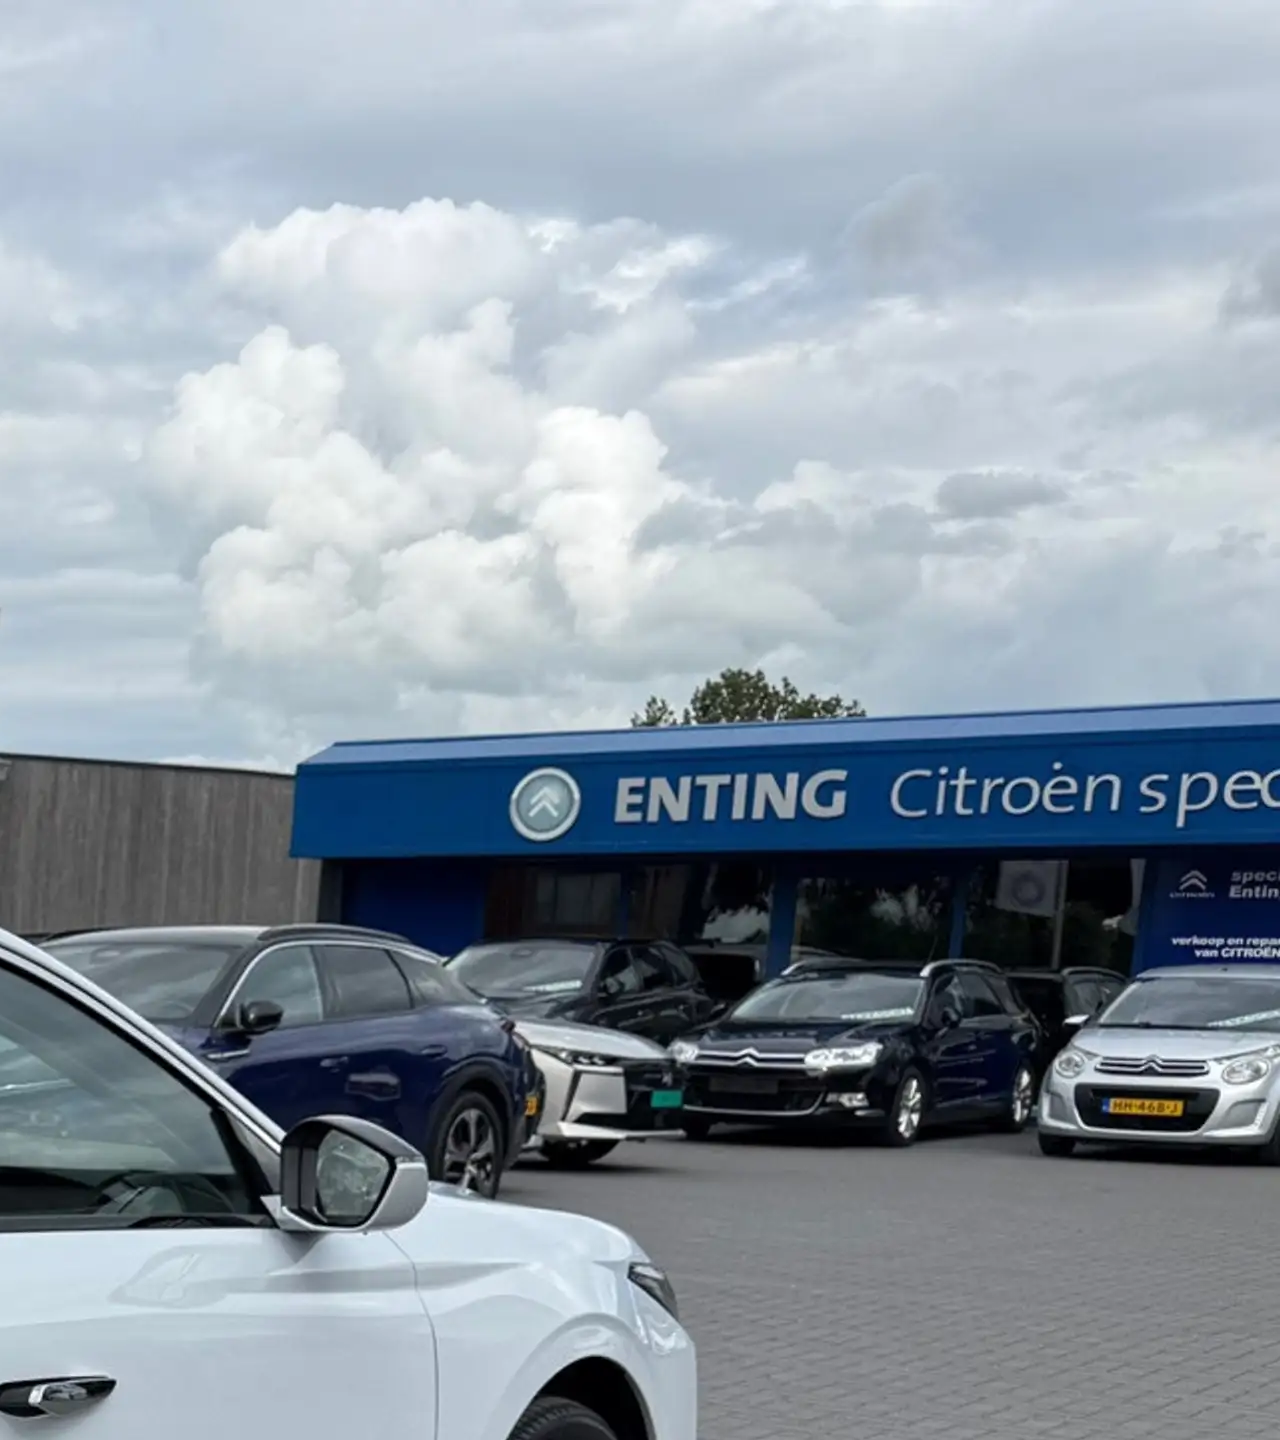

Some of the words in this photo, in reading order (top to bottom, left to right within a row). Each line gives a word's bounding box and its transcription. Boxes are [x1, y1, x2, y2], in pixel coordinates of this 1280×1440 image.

[614, 768, 848, 824] ENTING
[890, 760, 1123, 819] Citroën
[1139, 769, 1280, 829] spec
[1229, 885, 1280, 900] Entin
[1171, 934, 1225, 948] verkoop
[1226, 937, 1244, 946] en
[1194, 949, 1219, 958] van
